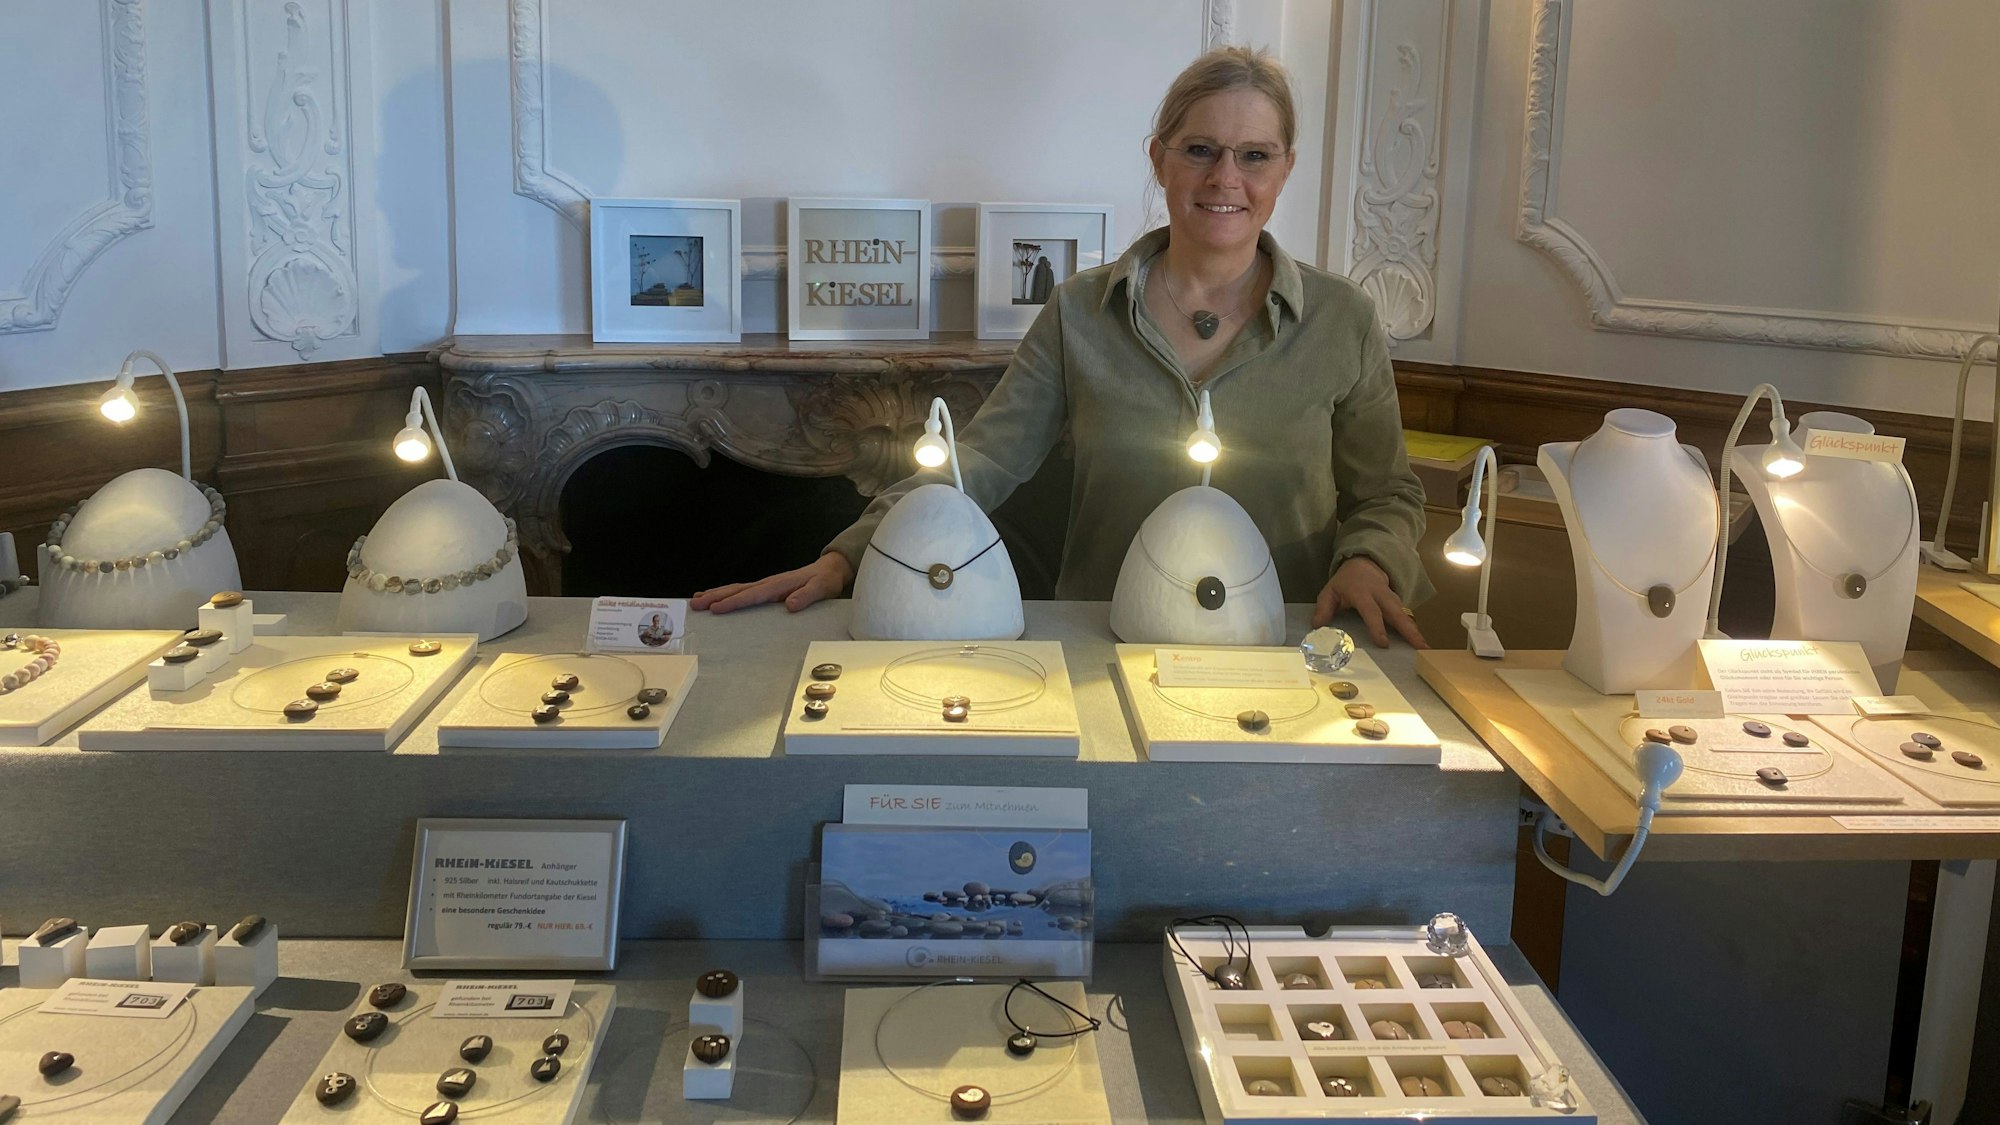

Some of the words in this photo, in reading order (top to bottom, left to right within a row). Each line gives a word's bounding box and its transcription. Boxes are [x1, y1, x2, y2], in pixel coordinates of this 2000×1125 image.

[806, 281, 912, 306] KiESEL
[1809, 435, 1899, 454] Glückspunkt
[1740, 646, 1819, 661] Glückspunkt
[1676, 695, 1695, 704] Gold
[869, 793, 908, 810] FÜR
[911, 797, 941, 810] SIE
[945, 802, 971, 811] zum
[975, 802, 1039, 812] Mitnehmen
[541, 863, 577, 871] Anhänger
[456, 892, 508, 900] Rheinkilometer
[510, 893, 562, 901] Fundortangabe
[576, 893, 597, 901] Kiesel
[497, 907, 546, 915] Geschenkidee
[488, 922, 513, 930] regulär
